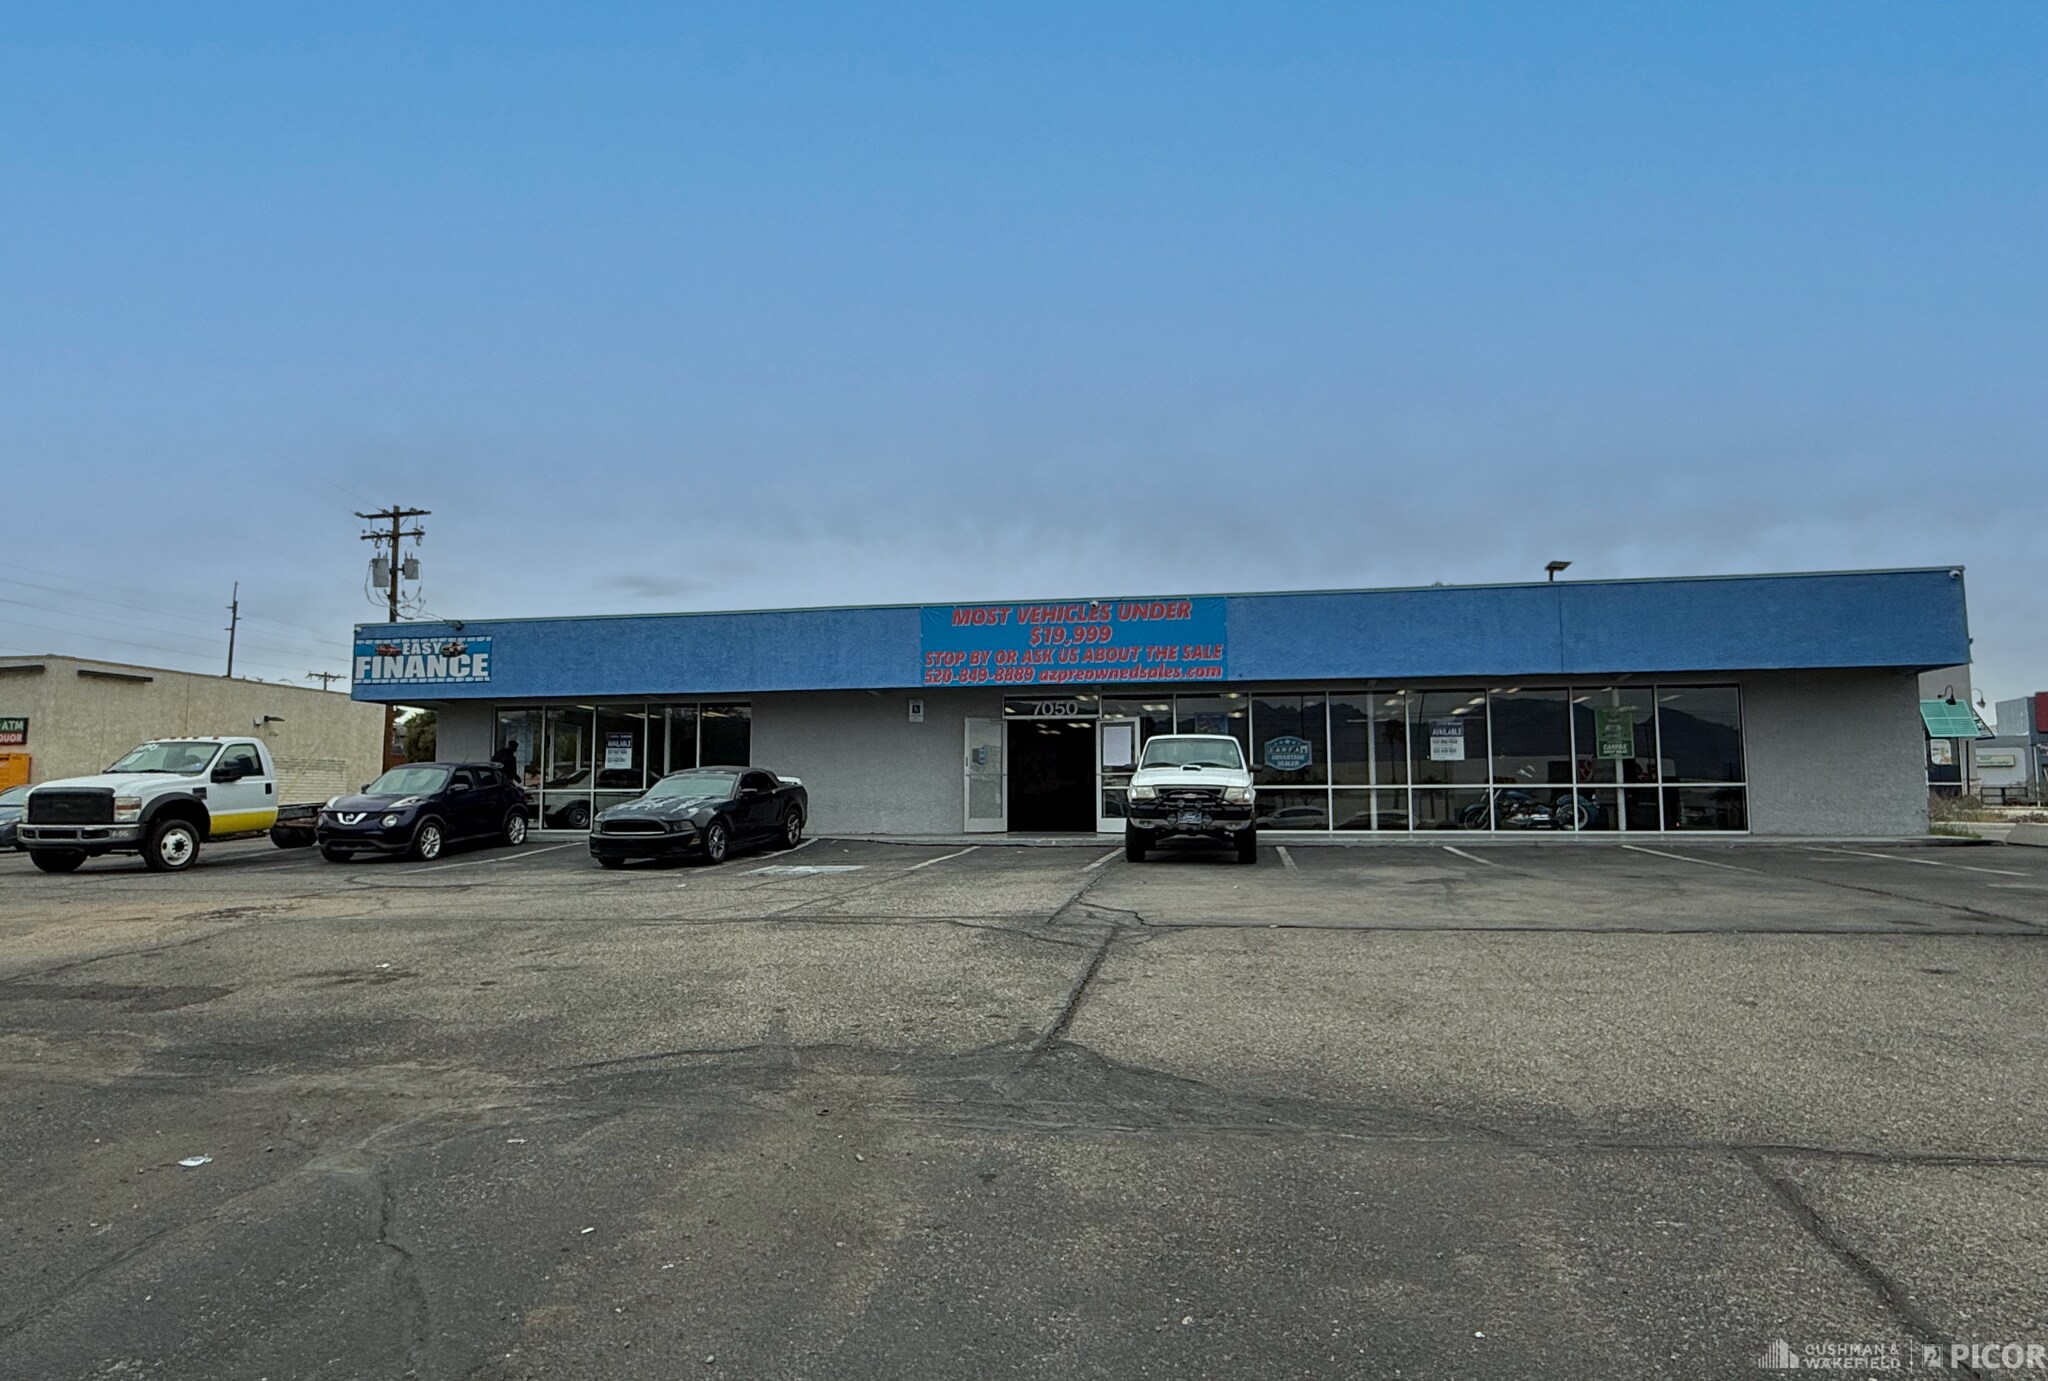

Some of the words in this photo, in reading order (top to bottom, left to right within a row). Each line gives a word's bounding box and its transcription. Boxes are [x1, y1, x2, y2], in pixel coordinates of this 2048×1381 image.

[952, 607, 1011, 626] MOST
[1017, 603, 1112, 625] VEHICLES
[1117, 601, 1192, 621] UNDER
[1029, 625, 1112, 647] $19,999
[402, 642, 443, 655] EASY
[925, 650, 966, 667] STOP
[969, 649, 991, 665] BY
[994, 648, 1018, 664] OR
[1021, 648, 1054, 664] ASK
[1058, 647, 1080, 663] US
[1082, 646, 1141, 662] ABOUT
[1146, 645, 1178, 661] THE
[1182, 644, 1223, 660] SALE
[355, 653, 489, 679] FINANCE
[923, 667, 1035, 684] 520-849-8889
[1039, 663, 1223, 684] azpreownedsales.com
[1032, 701, 1078, 716] 7050
[1, 720, 24, 731] ATM
[1432, 728, 1462, 736] AVAILABLE
